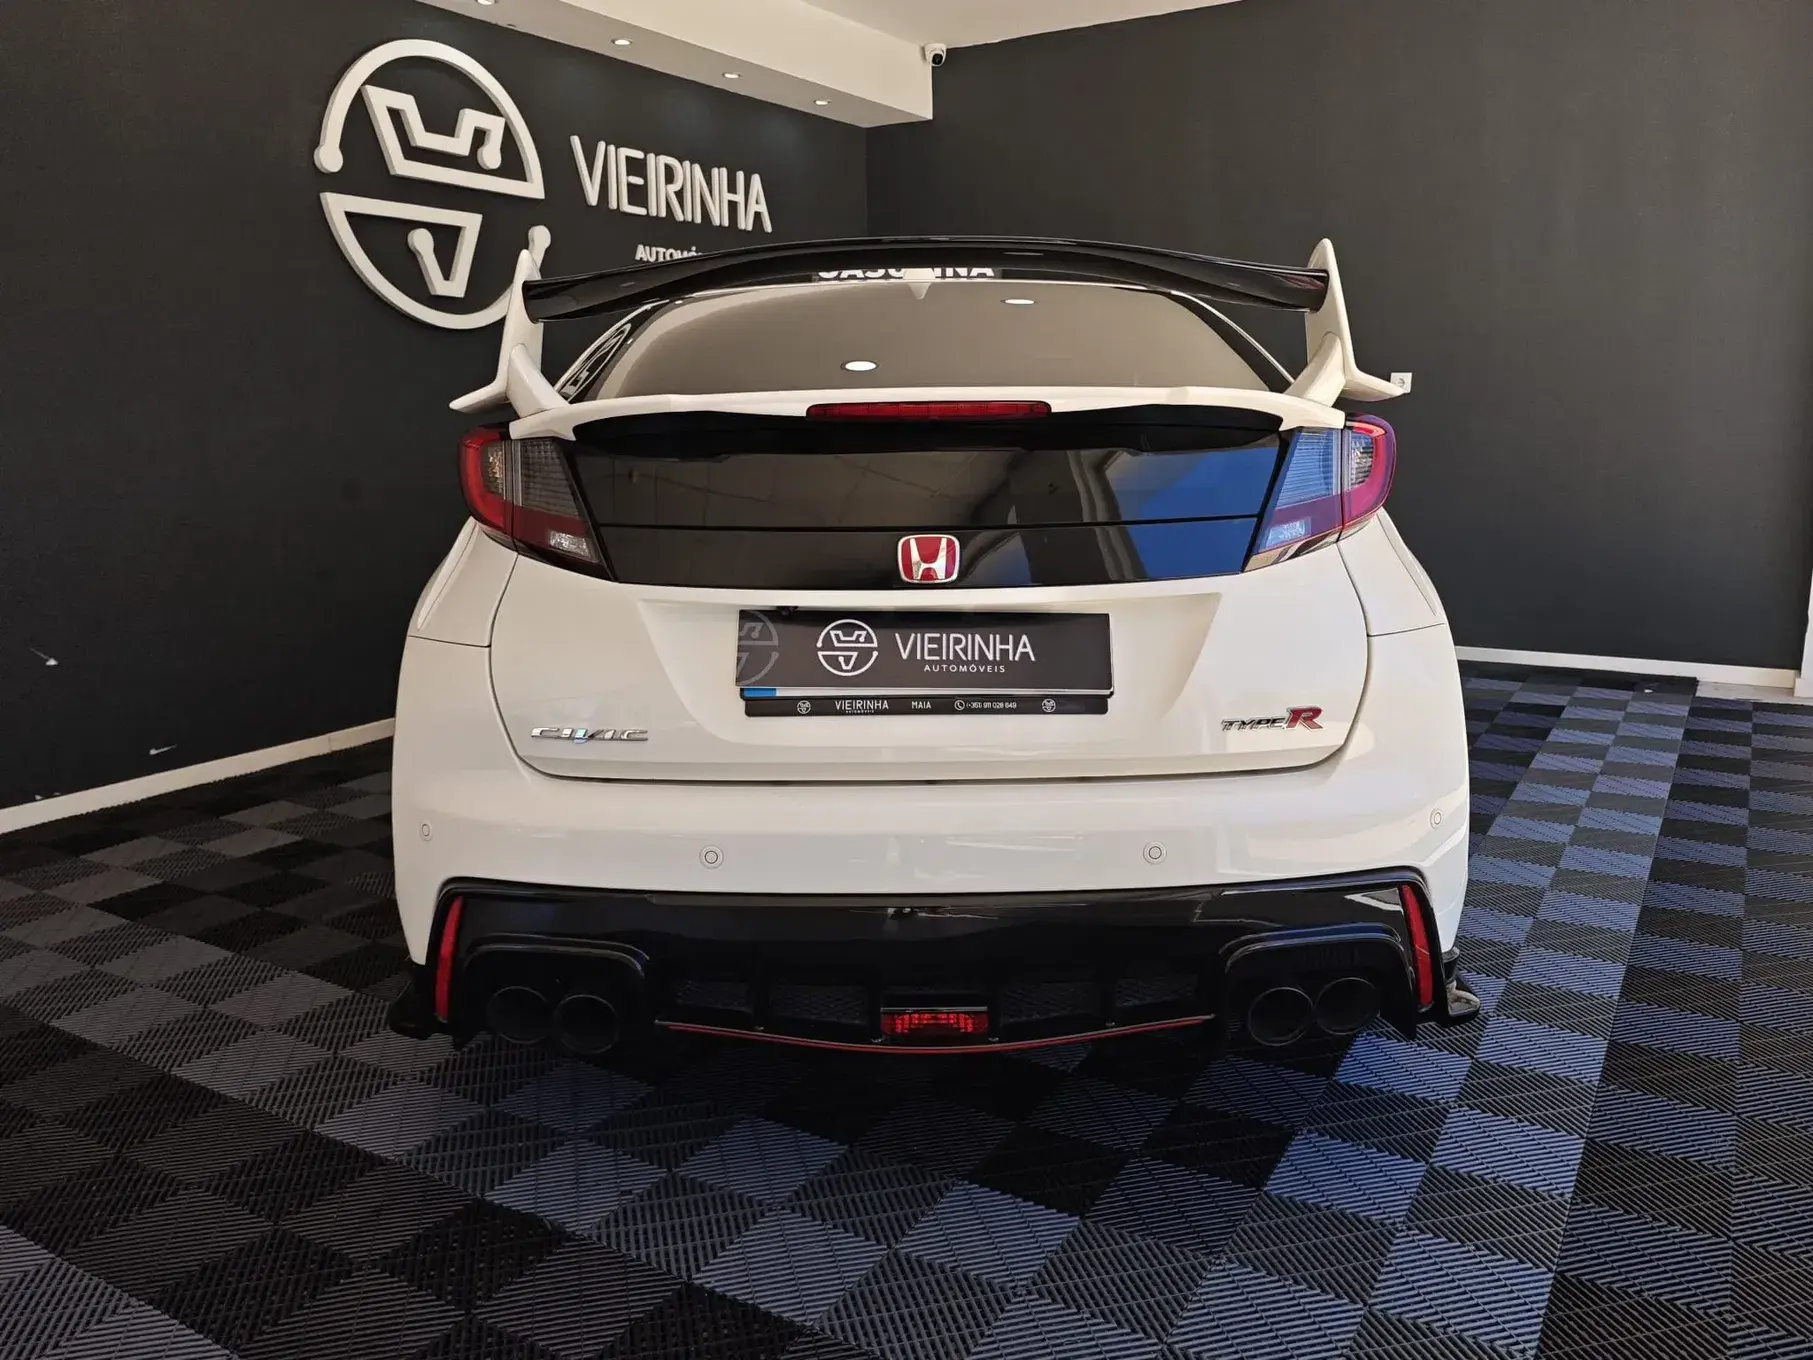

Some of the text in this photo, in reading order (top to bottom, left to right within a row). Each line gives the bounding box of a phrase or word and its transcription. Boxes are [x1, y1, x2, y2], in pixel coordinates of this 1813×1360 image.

[570, 135, 772, 233] VIEIRINHA
[894, 632, 1036, 661] VIEIRINHA
[835, 700, 889, 710] VIEIRINHA
[911, 701, 932, 709] MAIA
[531, 727, 648, 742] CIVIC
